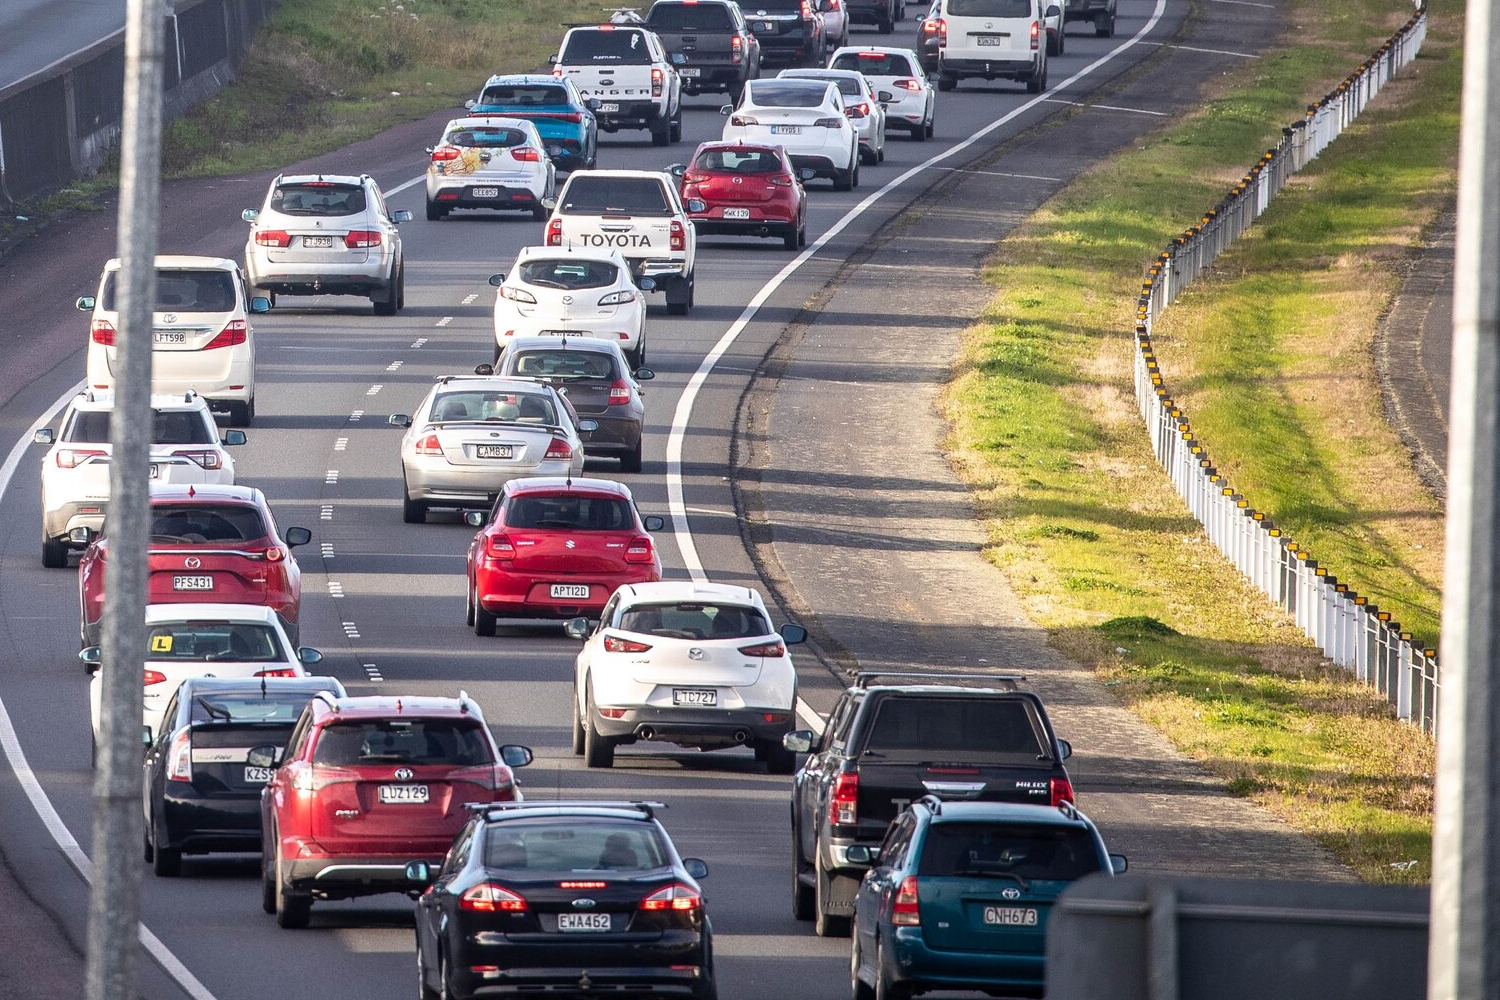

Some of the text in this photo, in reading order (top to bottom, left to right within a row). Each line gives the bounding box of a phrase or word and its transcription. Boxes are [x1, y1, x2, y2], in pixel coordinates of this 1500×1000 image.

[580, 88, 650, 96] ANGER
[580, 233, 652, 248] TOYOTA
[174, 577, 211, 588] PFS431
[157, 638, 167, 649] L
[673, 691, 715, 703] LTC727
[381, 787, 427, 799] LUZ129
[560, 915, 609, 928] EWA462
[986, 907, 1037, 925] CNH673
